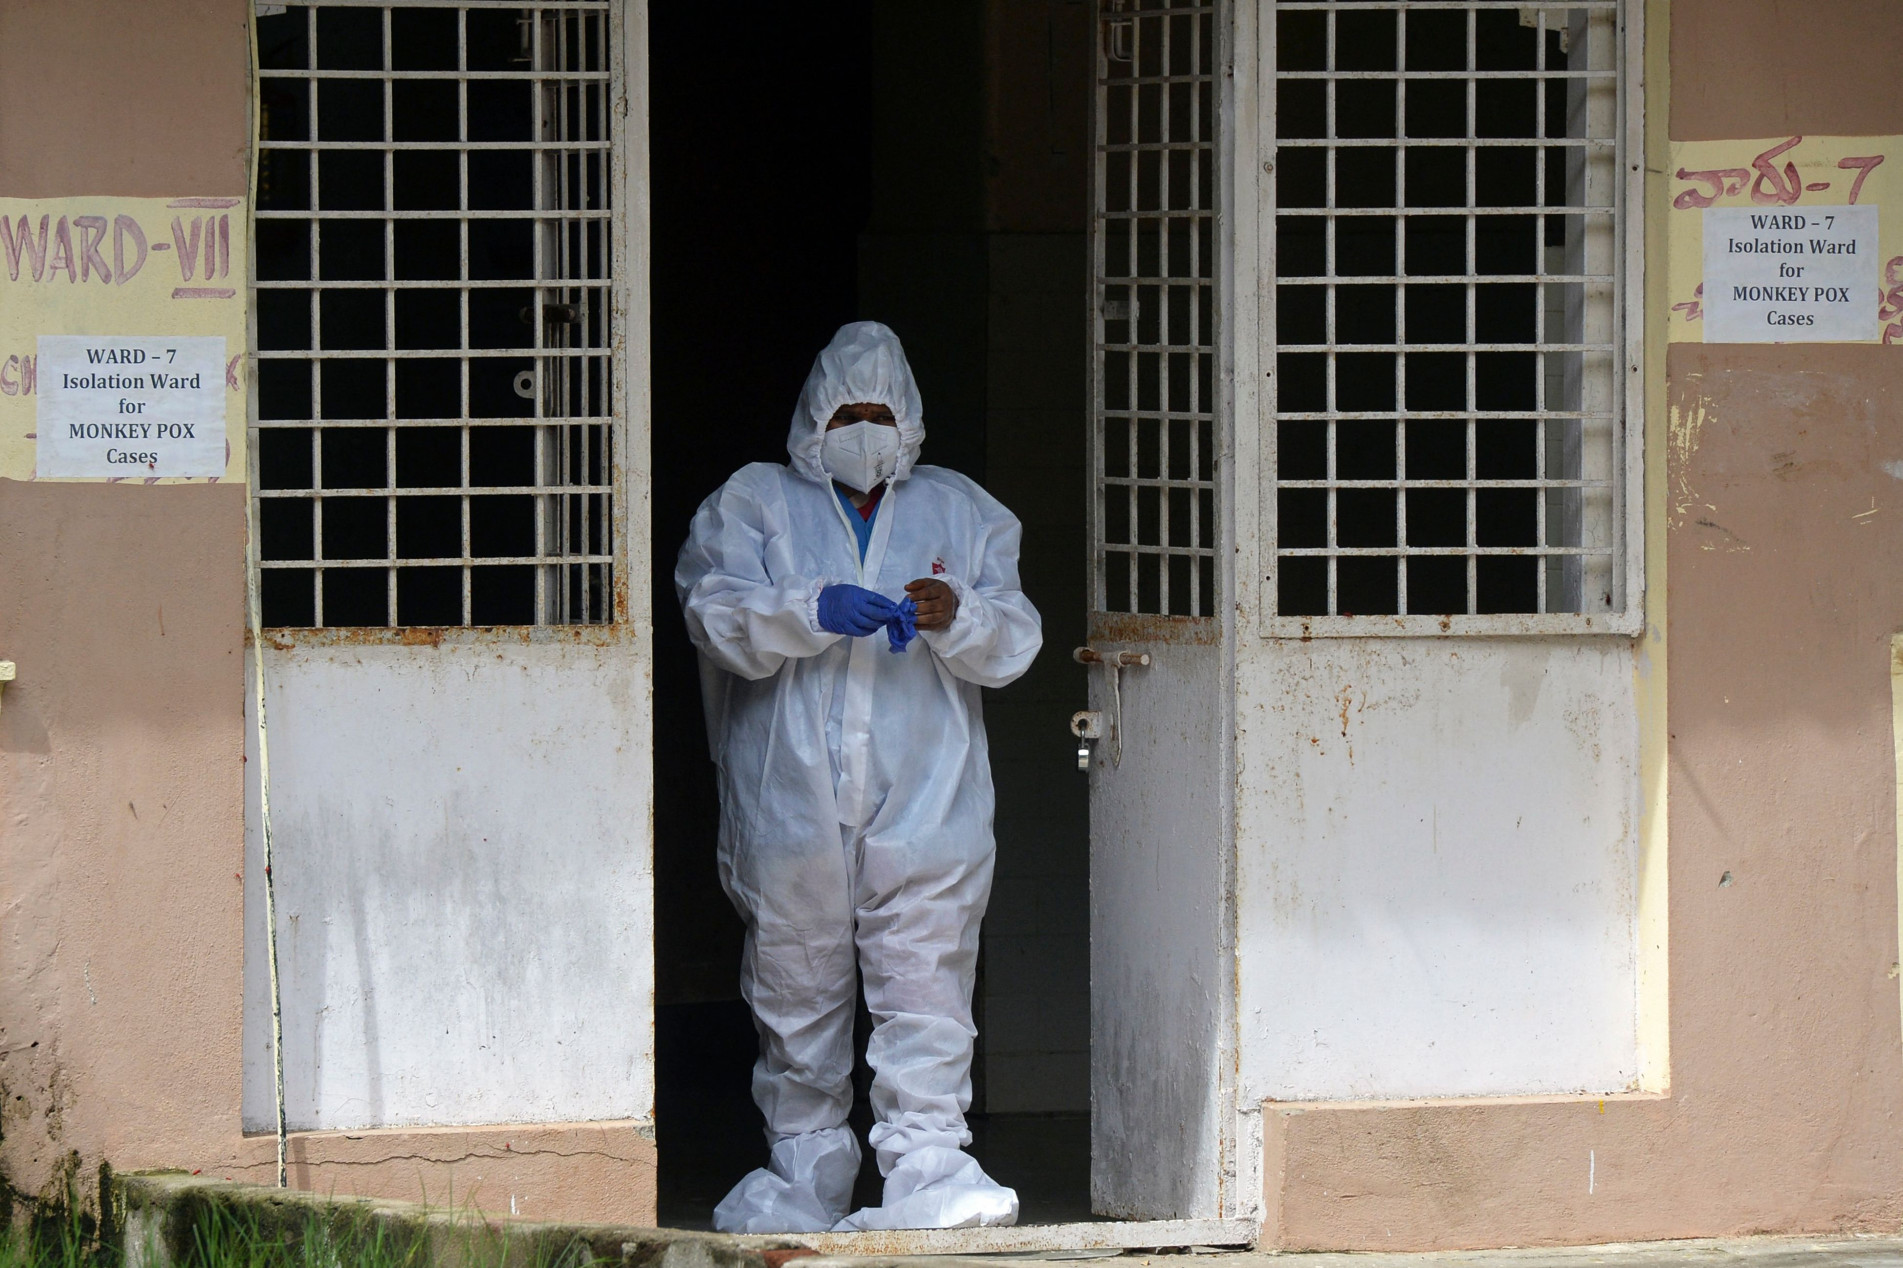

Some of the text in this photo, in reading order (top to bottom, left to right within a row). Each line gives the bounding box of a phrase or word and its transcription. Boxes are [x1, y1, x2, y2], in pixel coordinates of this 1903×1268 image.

[1750, 214, 1806, 230] WARD
[1824, 215, 1835, 230] 7
[1728, 238, 1856, 255] Isolation Ward
[1779, 262, 1805, 278] for
[1733, 286, 1850, 303] MONKEY POX
[1767, 310, 1815, 326] Cases
[86, 348, 146, 364] WARD
[166, 348, 177, 364] 7
[63, 372, 201, 389] Isolation Ward
[119, 397, 146, 414] for
[69, 423, 195, 439] MONKEY POX
[106, 448, 158, 464] Cases
